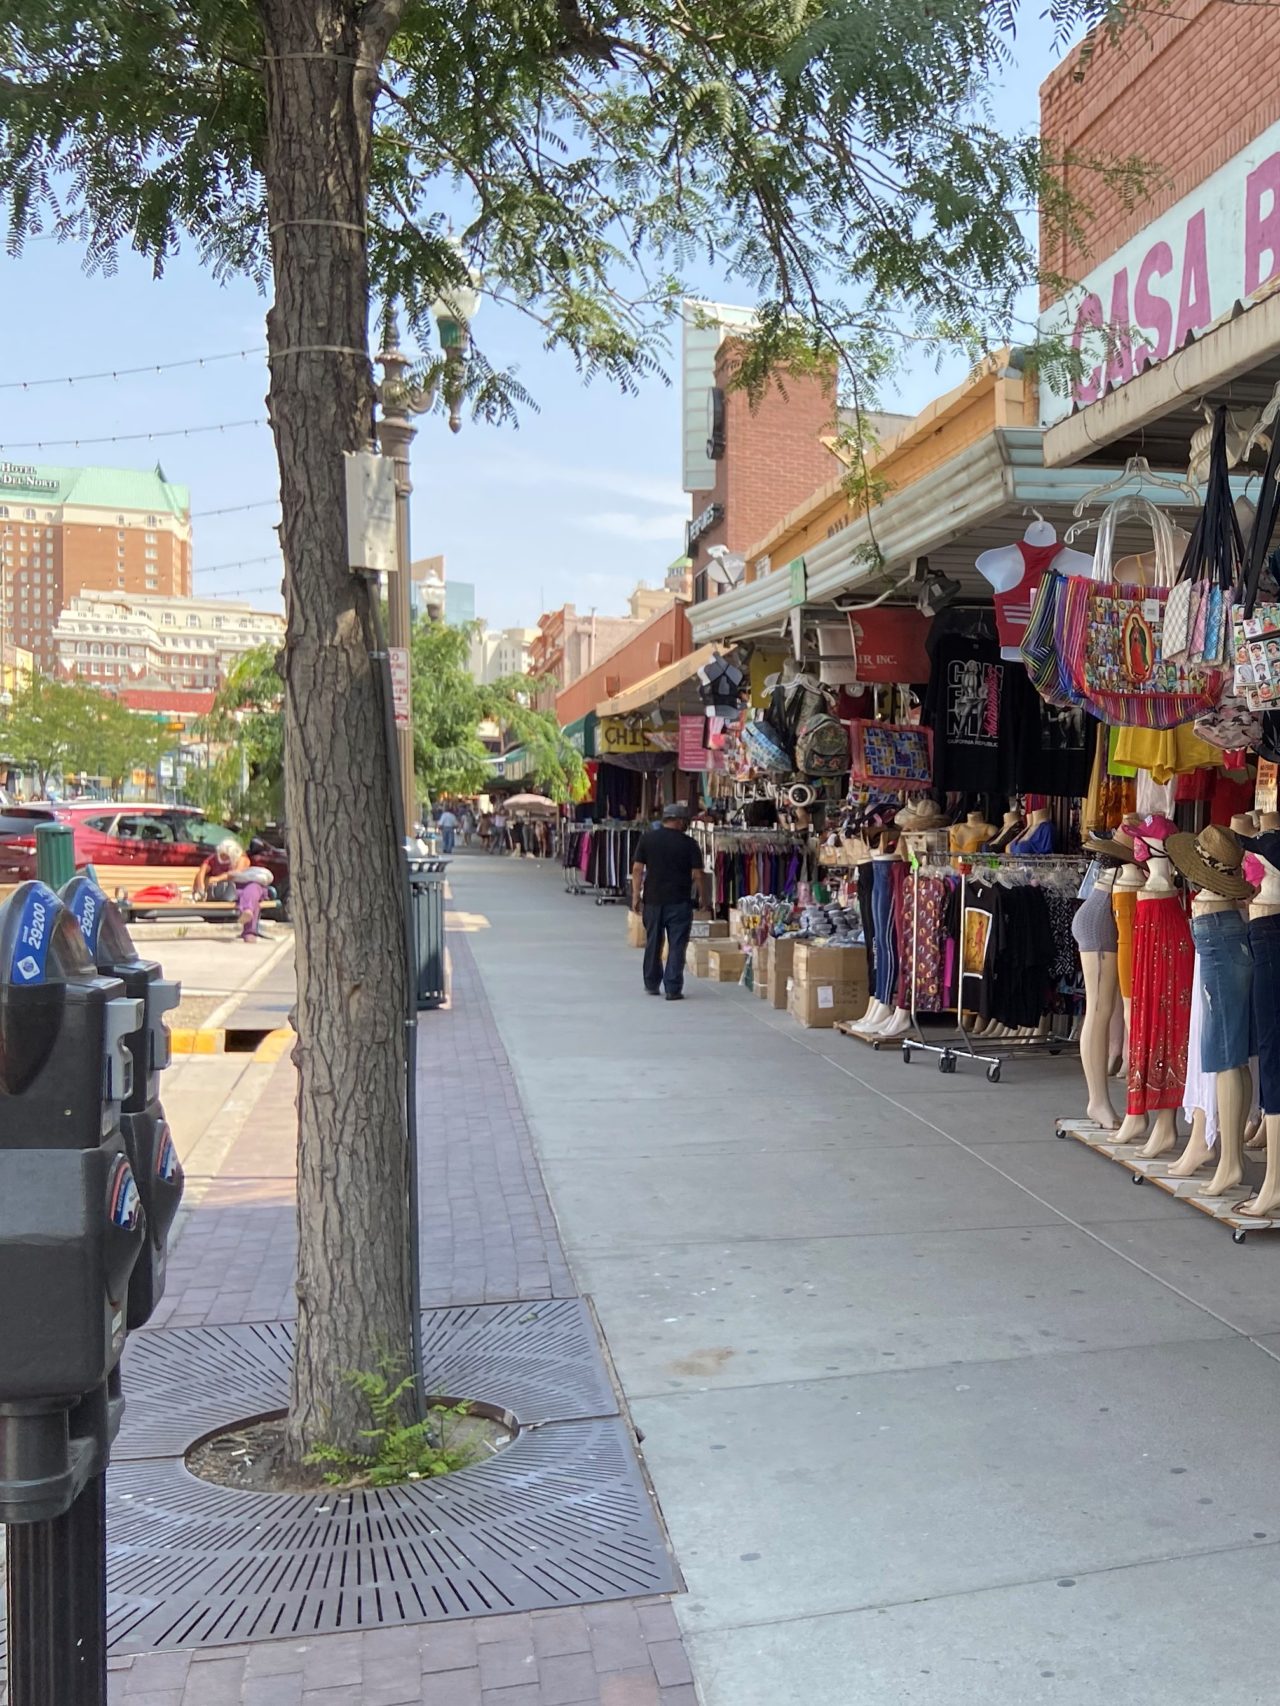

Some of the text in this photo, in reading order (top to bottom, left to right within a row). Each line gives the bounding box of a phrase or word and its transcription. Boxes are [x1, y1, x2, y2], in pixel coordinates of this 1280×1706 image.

[1070, 207, 1213, 404] CASA
[1, 463, 35, 474] HOTEL
[3, 474, 58, 488] DEL NORTE
[28, 902, 46, 950] 29200
[80, 895, 95, 937] 29200
